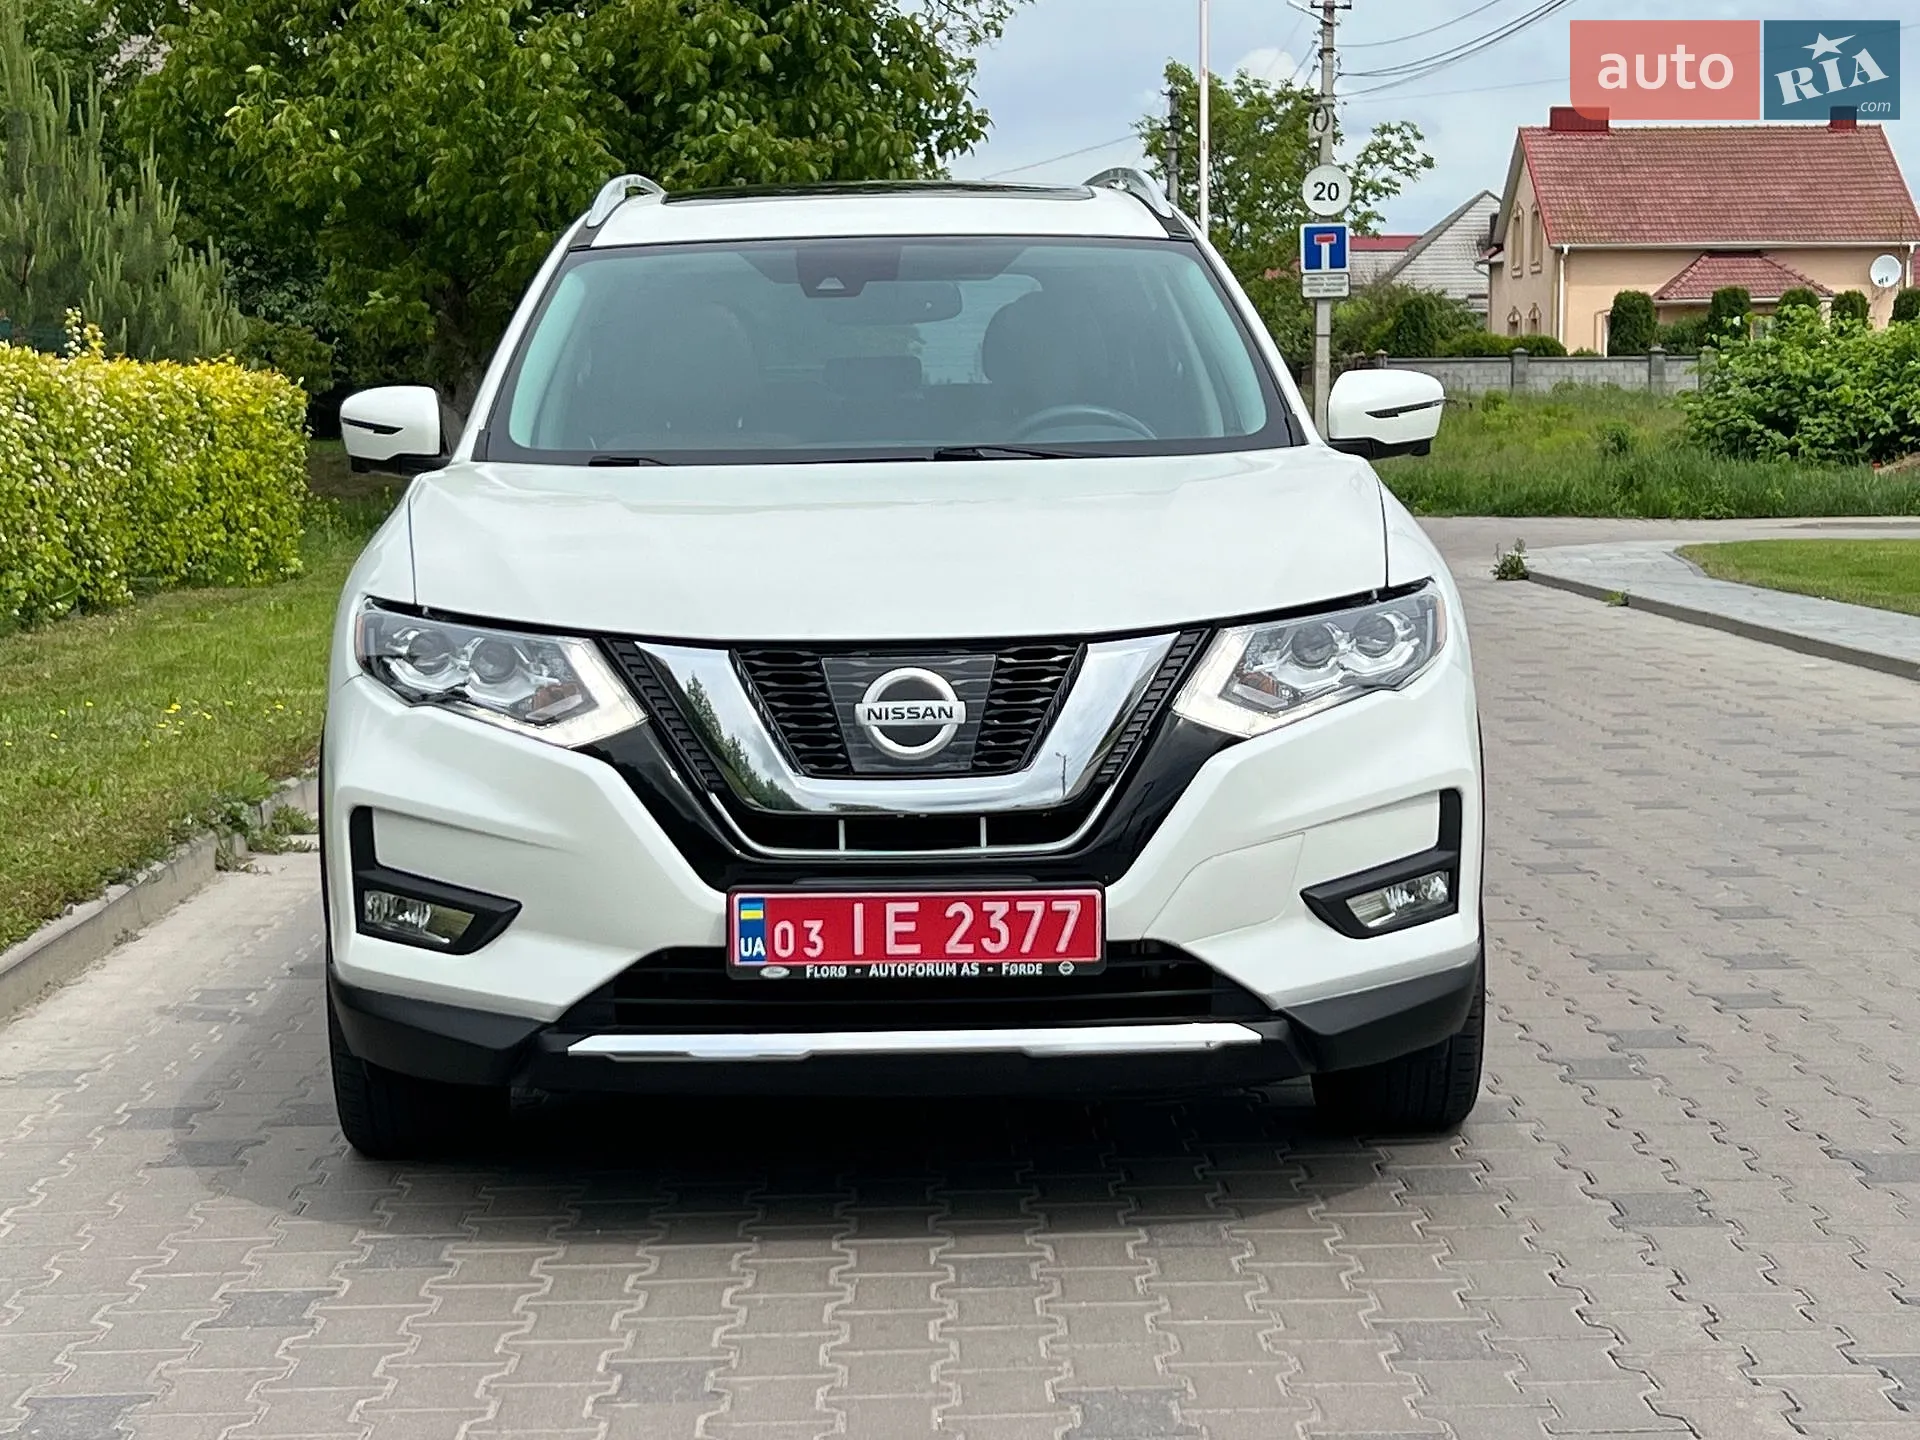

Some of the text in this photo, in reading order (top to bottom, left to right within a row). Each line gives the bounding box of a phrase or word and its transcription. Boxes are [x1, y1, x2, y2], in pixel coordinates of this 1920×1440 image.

[1313, 182, 1340, 201] 20
[867, 706, 953, 721] NISSAN
[773, 920, 825, 958] 03
[944, 900, 1082, 955] 2377
[740, 937, 766, 957] UA
[868, 963, 956, 977] AUTOFORUM
[960, 962, 979, 976] AS
